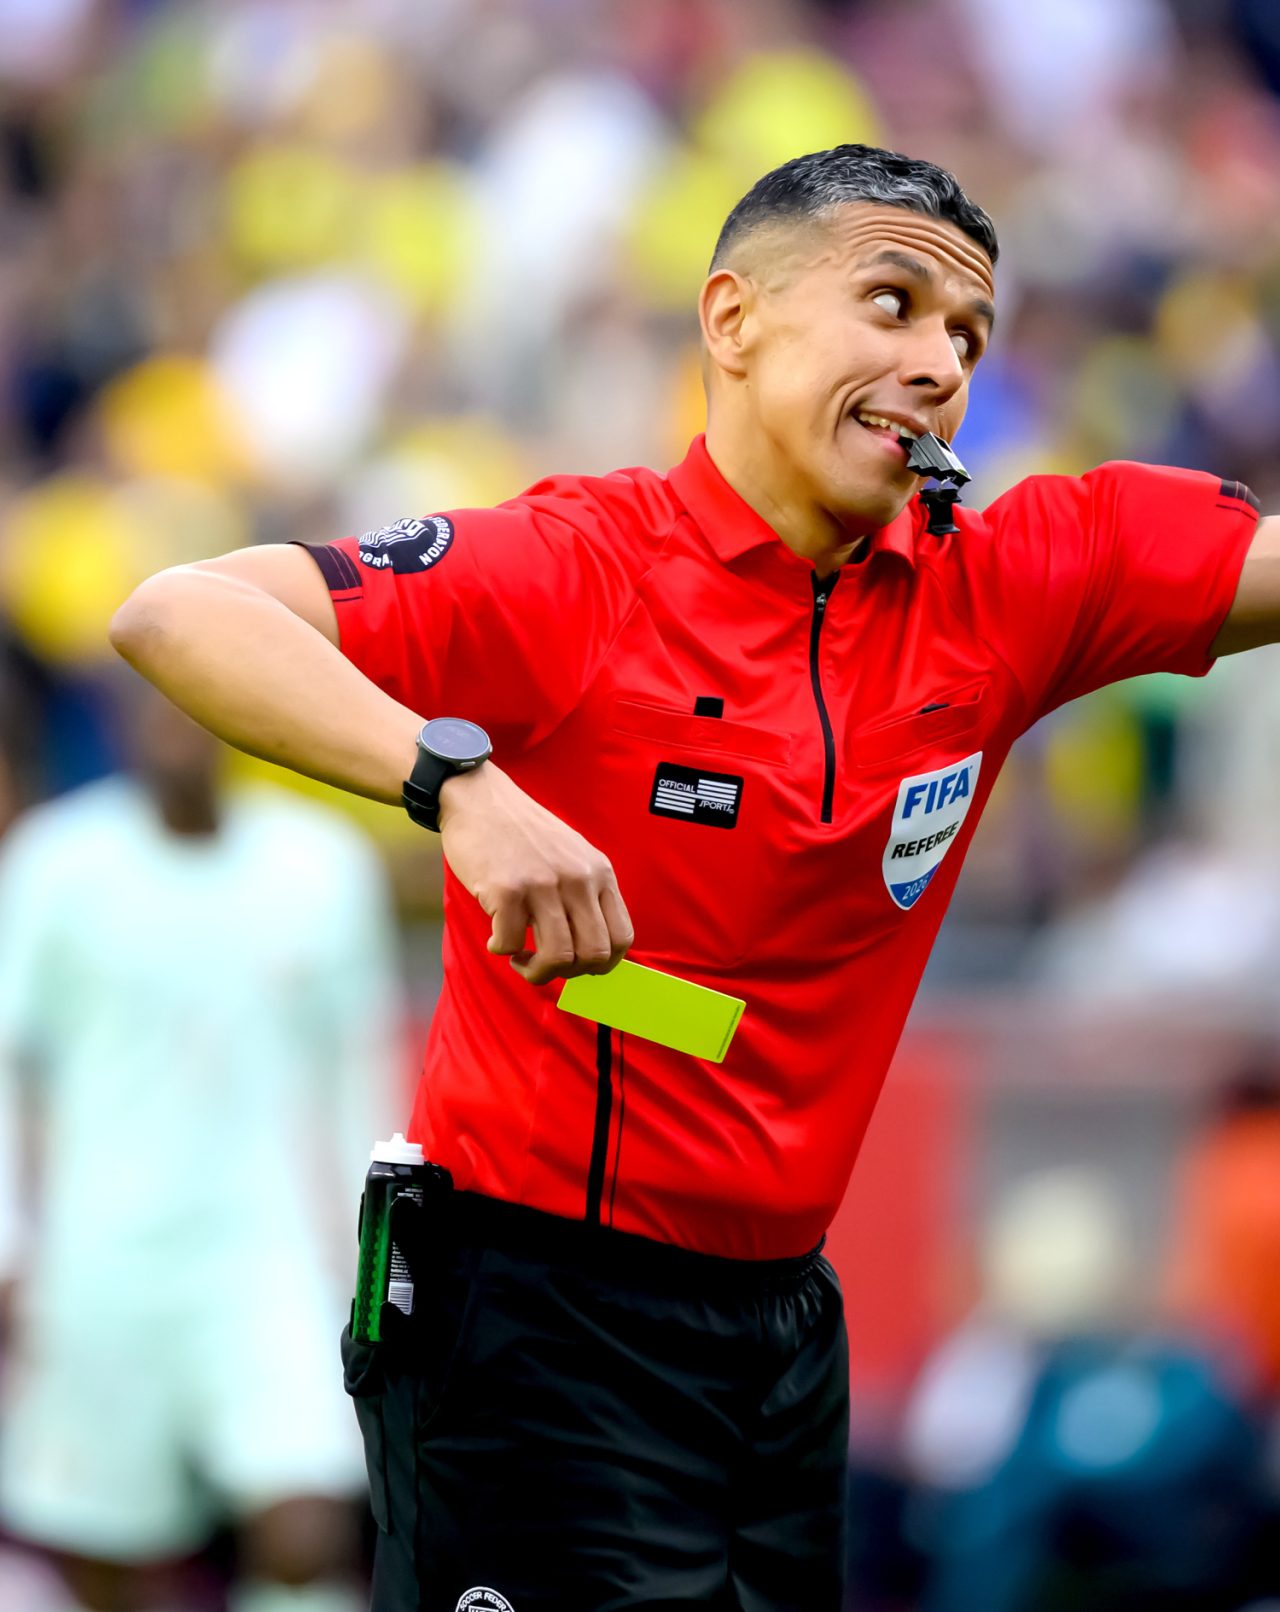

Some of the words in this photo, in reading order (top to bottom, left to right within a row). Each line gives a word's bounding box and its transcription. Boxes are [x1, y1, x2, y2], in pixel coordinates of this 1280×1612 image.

[658, 778, 695, 794] OFFICIAL
[901, 766, 970, 820] FIFA
[891, 820, 960, 860] REFEREE
[459, 1590, 483, 1612] SOCCER
